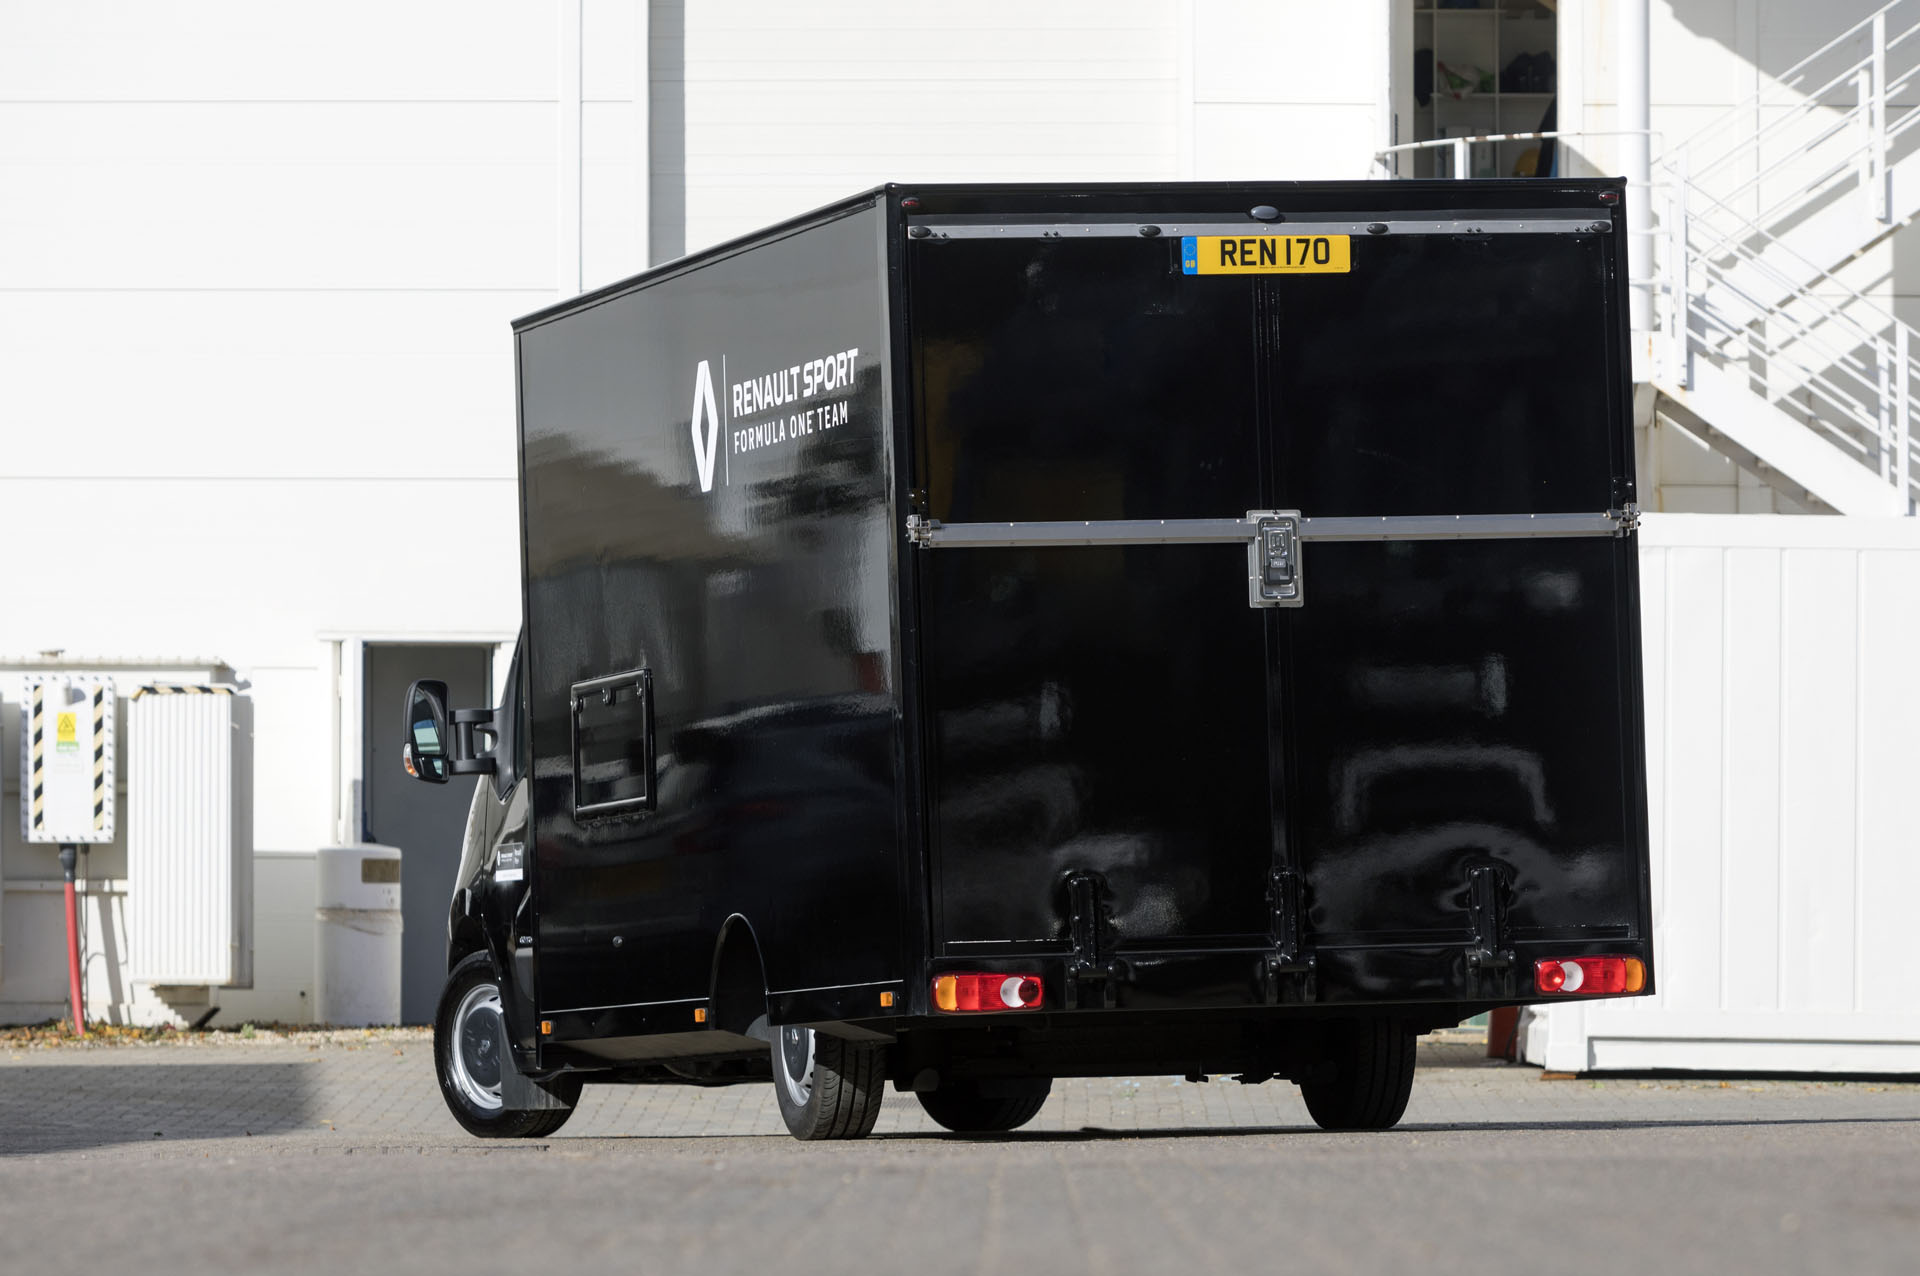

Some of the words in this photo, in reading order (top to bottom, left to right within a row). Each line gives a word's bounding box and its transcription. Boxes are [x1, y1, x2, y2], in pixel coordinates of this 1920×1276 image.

[1220, 238, 1277, 266] REN
[1285, 237, 1330, 265] 170
[732, 365, 801, 418] RENAULT
[802, 347, 859, 398] SPORT
[733, 418, 786, 454] FORMULA
[789, 409, 815, 439] ONE
[816, 400, 848, 436] TEAM
